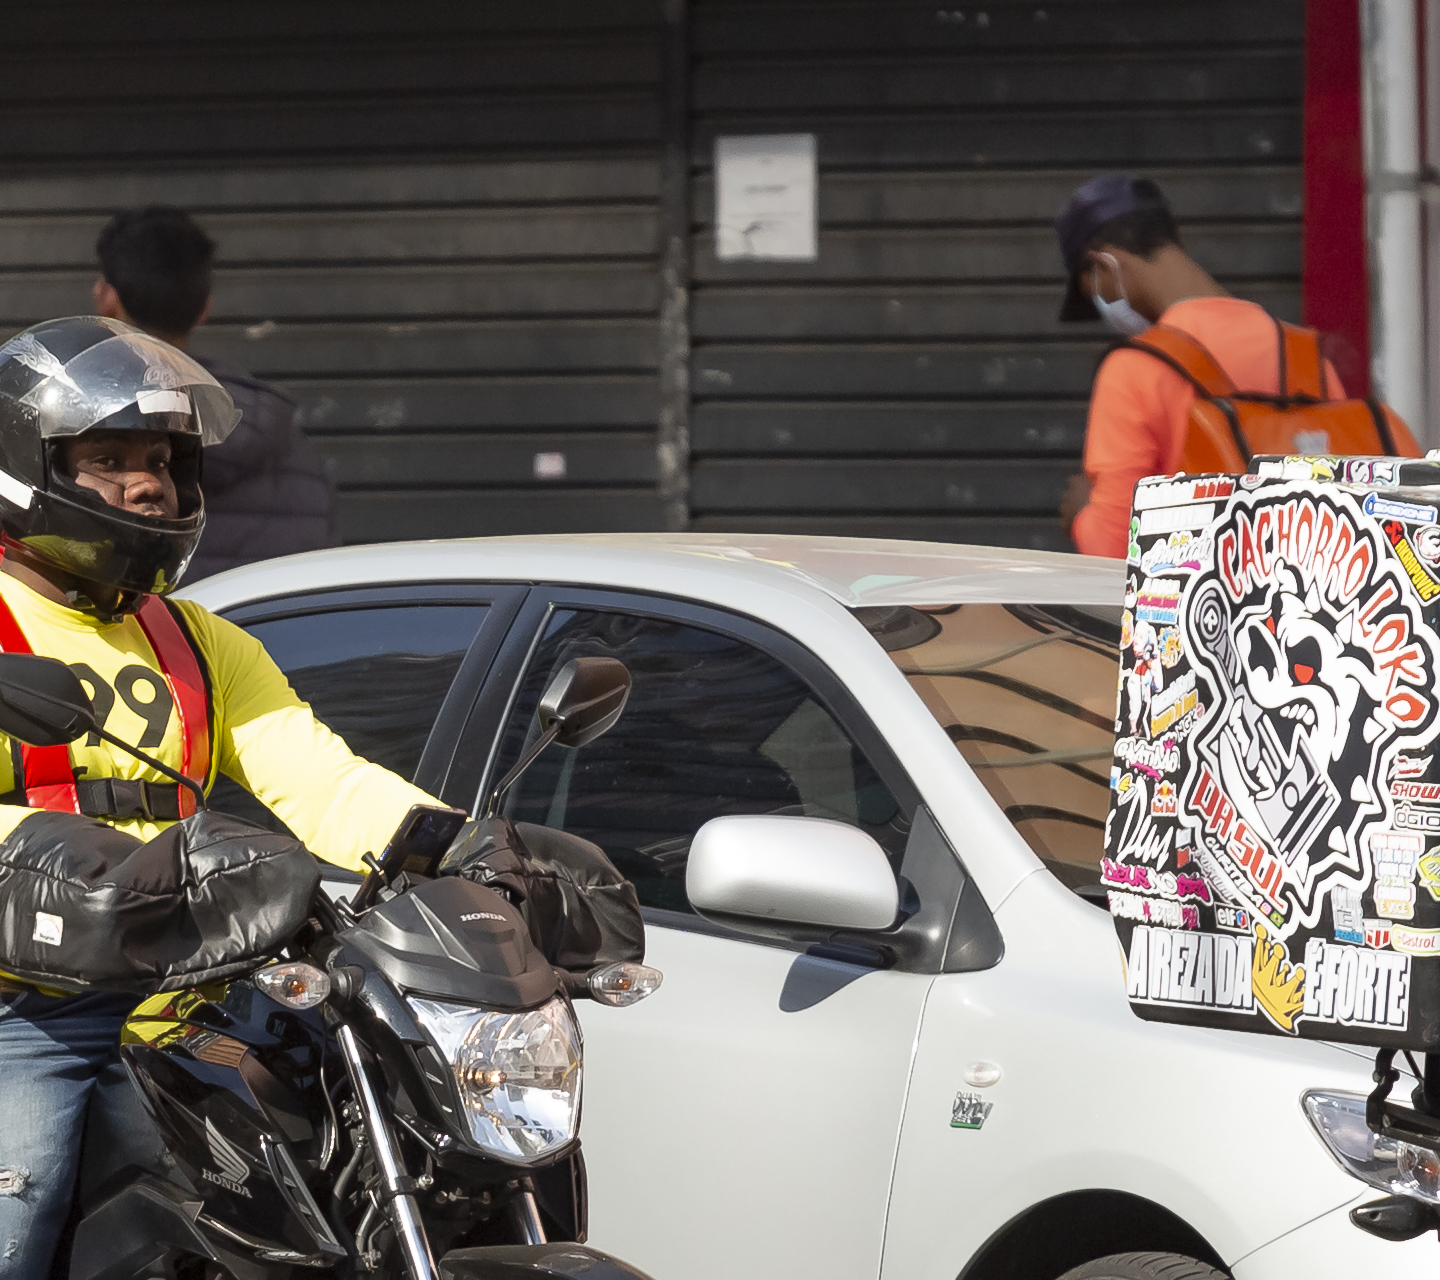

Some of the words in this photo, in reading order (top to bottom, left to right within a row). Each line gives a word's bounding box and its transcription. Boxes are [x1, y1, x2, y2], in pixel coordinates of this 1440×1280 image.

[1222, 505, 1366, 604] CACHORRO
[1359, 586, 1427, 723] LOKO
[460, 911, 507, 923] HONDA
[1217, 908, 1237, 925] elf
[1401, 934, 1436, 949] Castrol
[1129, 927, 1148, 1000] A
[1151, 929, 1213, 1003] REZA
[1216, 934, 1253, 1008] DA
[1324, 947, 1407, 1026] FORTE
[202, 1167, 254, 1201] HONDA
